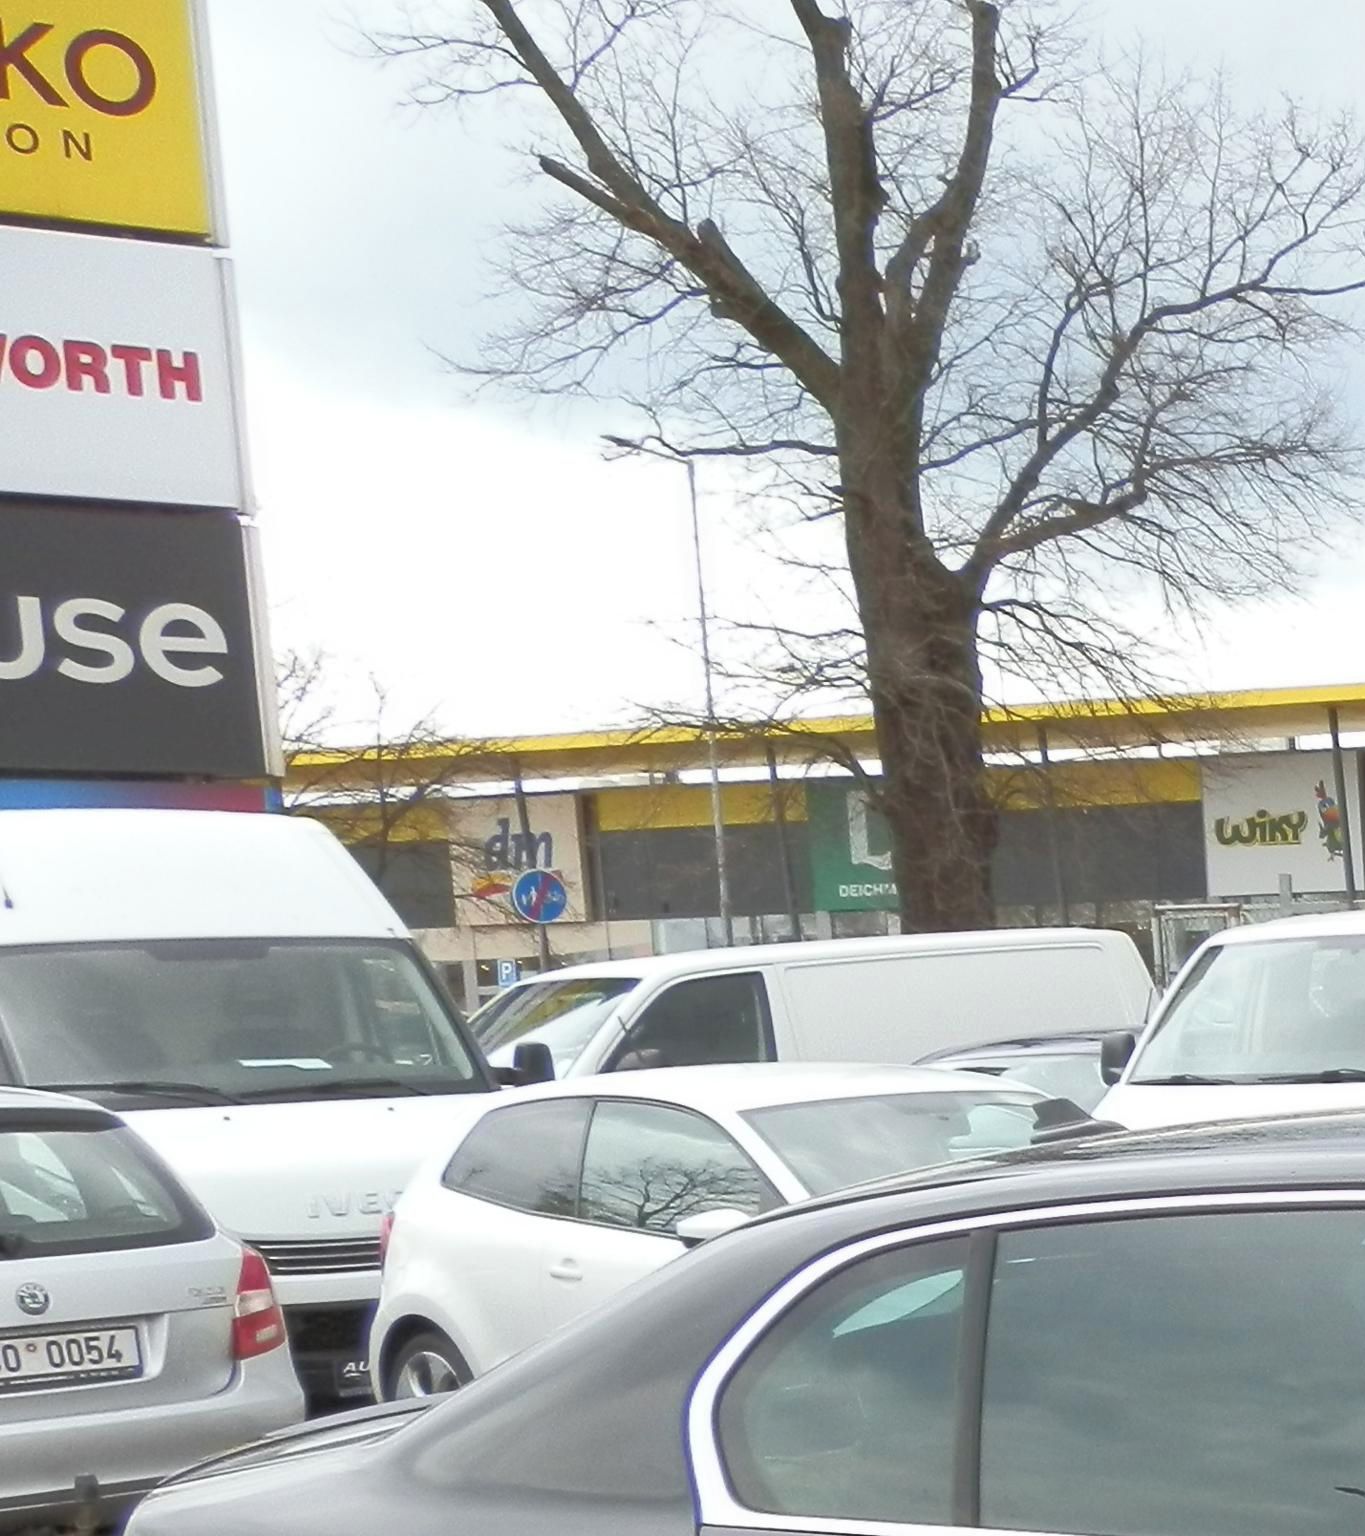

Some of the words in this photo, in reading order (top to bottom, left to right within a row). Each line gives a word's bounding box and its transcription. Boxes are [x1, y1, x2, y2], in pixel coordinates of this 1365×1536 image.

[0, 333, 203, 402] ORTH
[0, 1343, 21, 1373] 0
[46, 1335, 123, 1369] 0054
